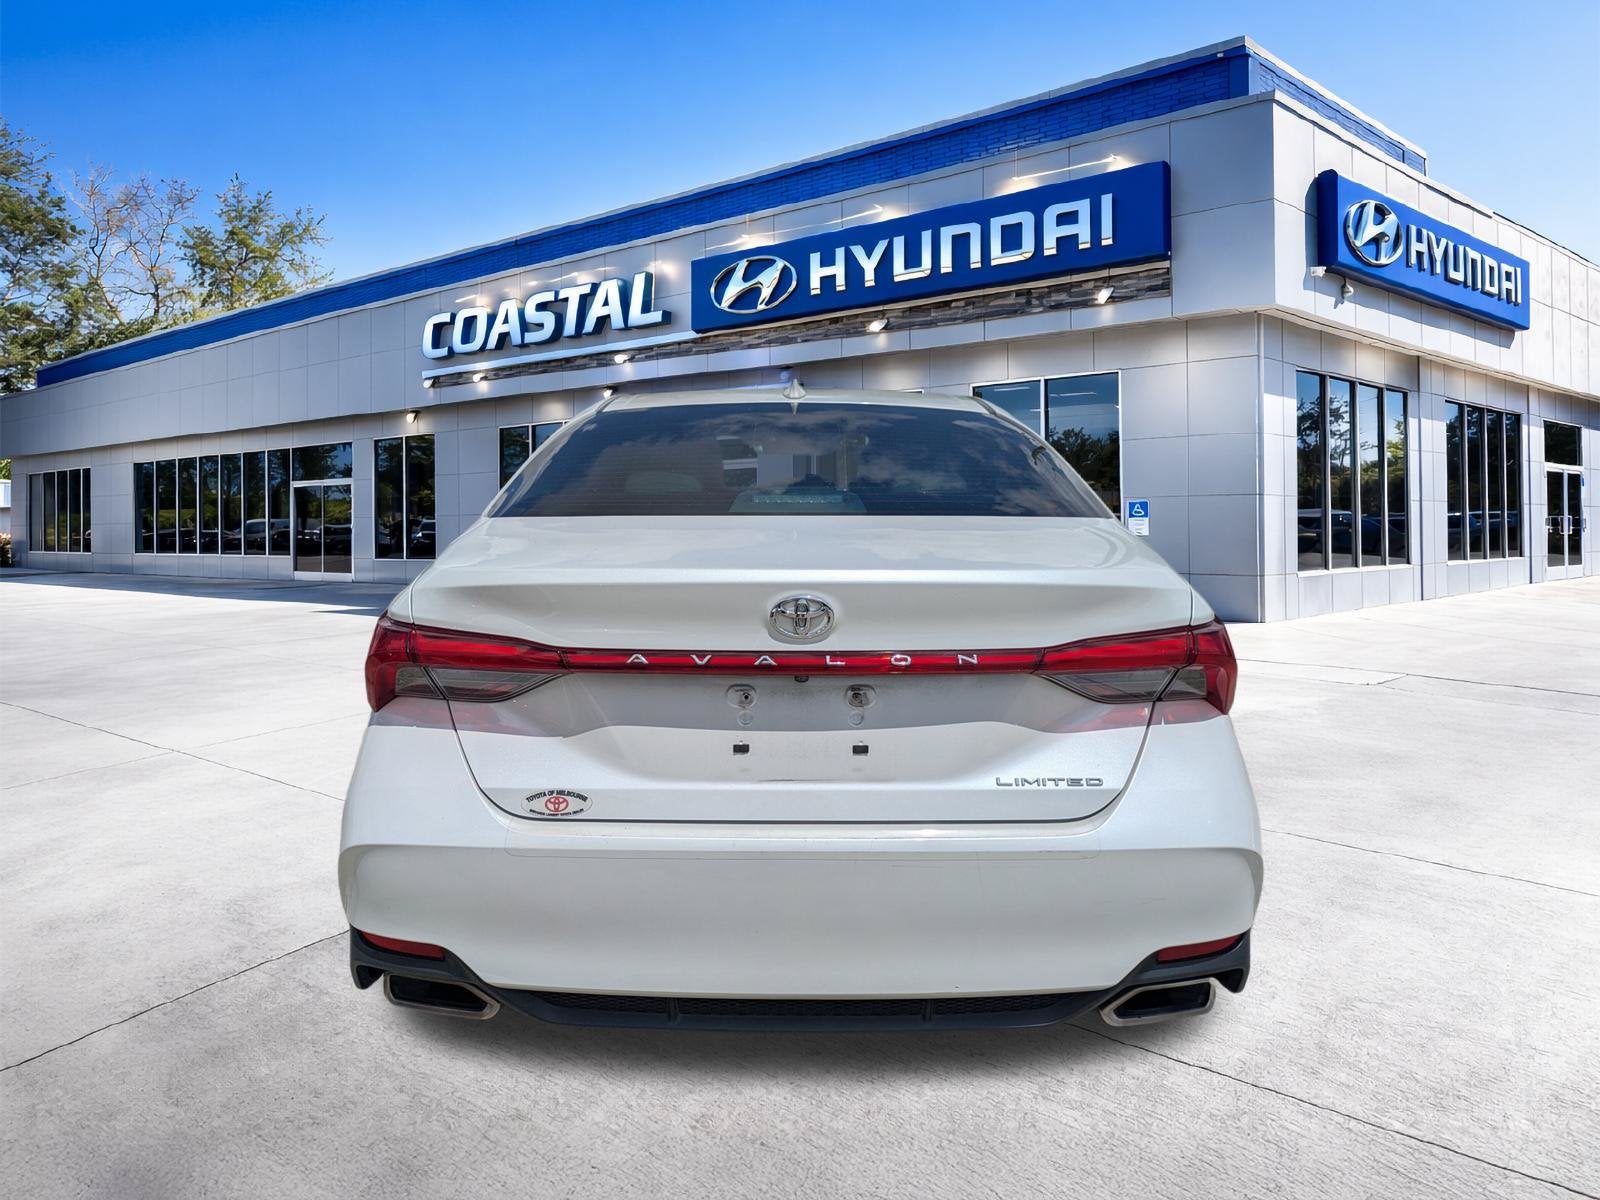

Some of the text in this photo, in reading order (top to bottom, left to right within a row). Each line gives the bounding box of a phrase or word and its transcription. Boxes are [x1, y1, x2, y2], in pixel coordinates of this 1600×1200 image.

[809, 193, 1114, 295] HYUNDAI
[1406, 224, 1522, 306] HYUNDAI
[422, 271, 671, 360] COASTAL
[626, 652, 980, 667] AVALON
[525, 790, 547, 802] TOYOTA
[995, 777, 1104, 787] LIMITED
